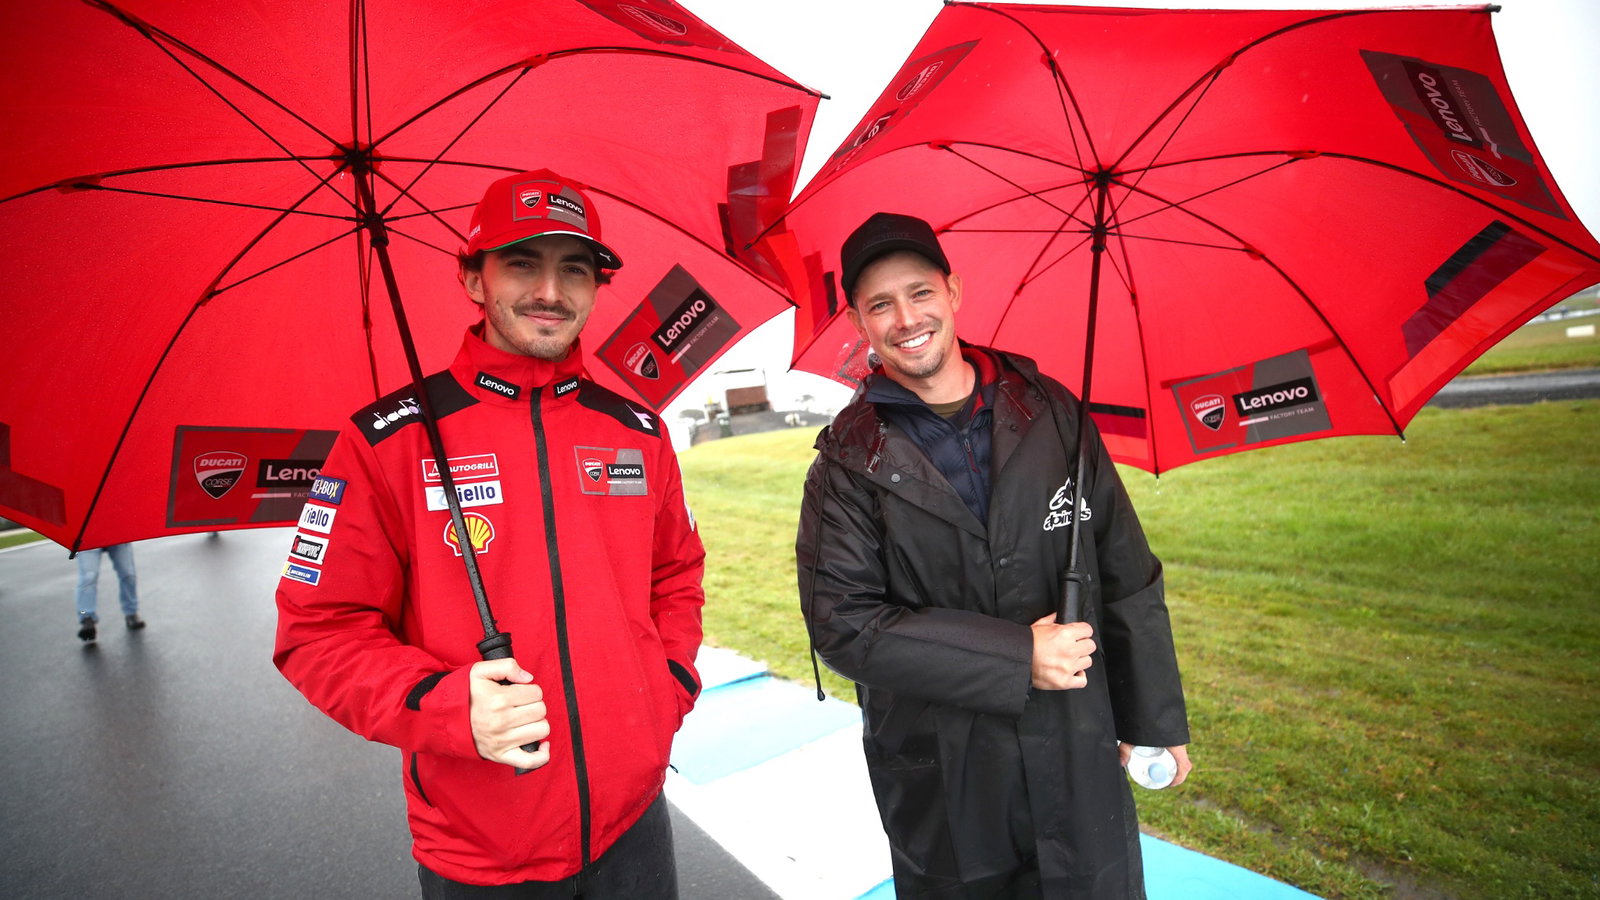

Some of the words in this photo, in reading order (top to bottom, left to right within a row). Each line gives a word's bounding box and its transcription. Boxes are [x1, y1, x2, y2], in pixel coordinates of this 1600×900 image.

[1418, 72, 1473, 142] Lenovo
[550, 195, 583, 214] Lenovo
[657, 299, 706, 347] Lenovo
[627, 346, 646, 367] DUCATI
[479, 375, 515, 396] Lenovo
[556, 380, 578, 395] Lenovo
[1194, 398, 1221, 410] DUCATI
[1240, 386, 1308, 410] Lenovo
[373, 398, 420, 430] diado
[1270, 411, 1295, 421] FACTORY
[1296, 407, 1314, 416] TEAM
[200, 458, 242, 467] DUCATI
[266, 464, 322, 480] Leno
[608, 466, 641, 475] Lenovo
[457, 485, 496, 502] iello
[304, 507, 330, 527] riello
